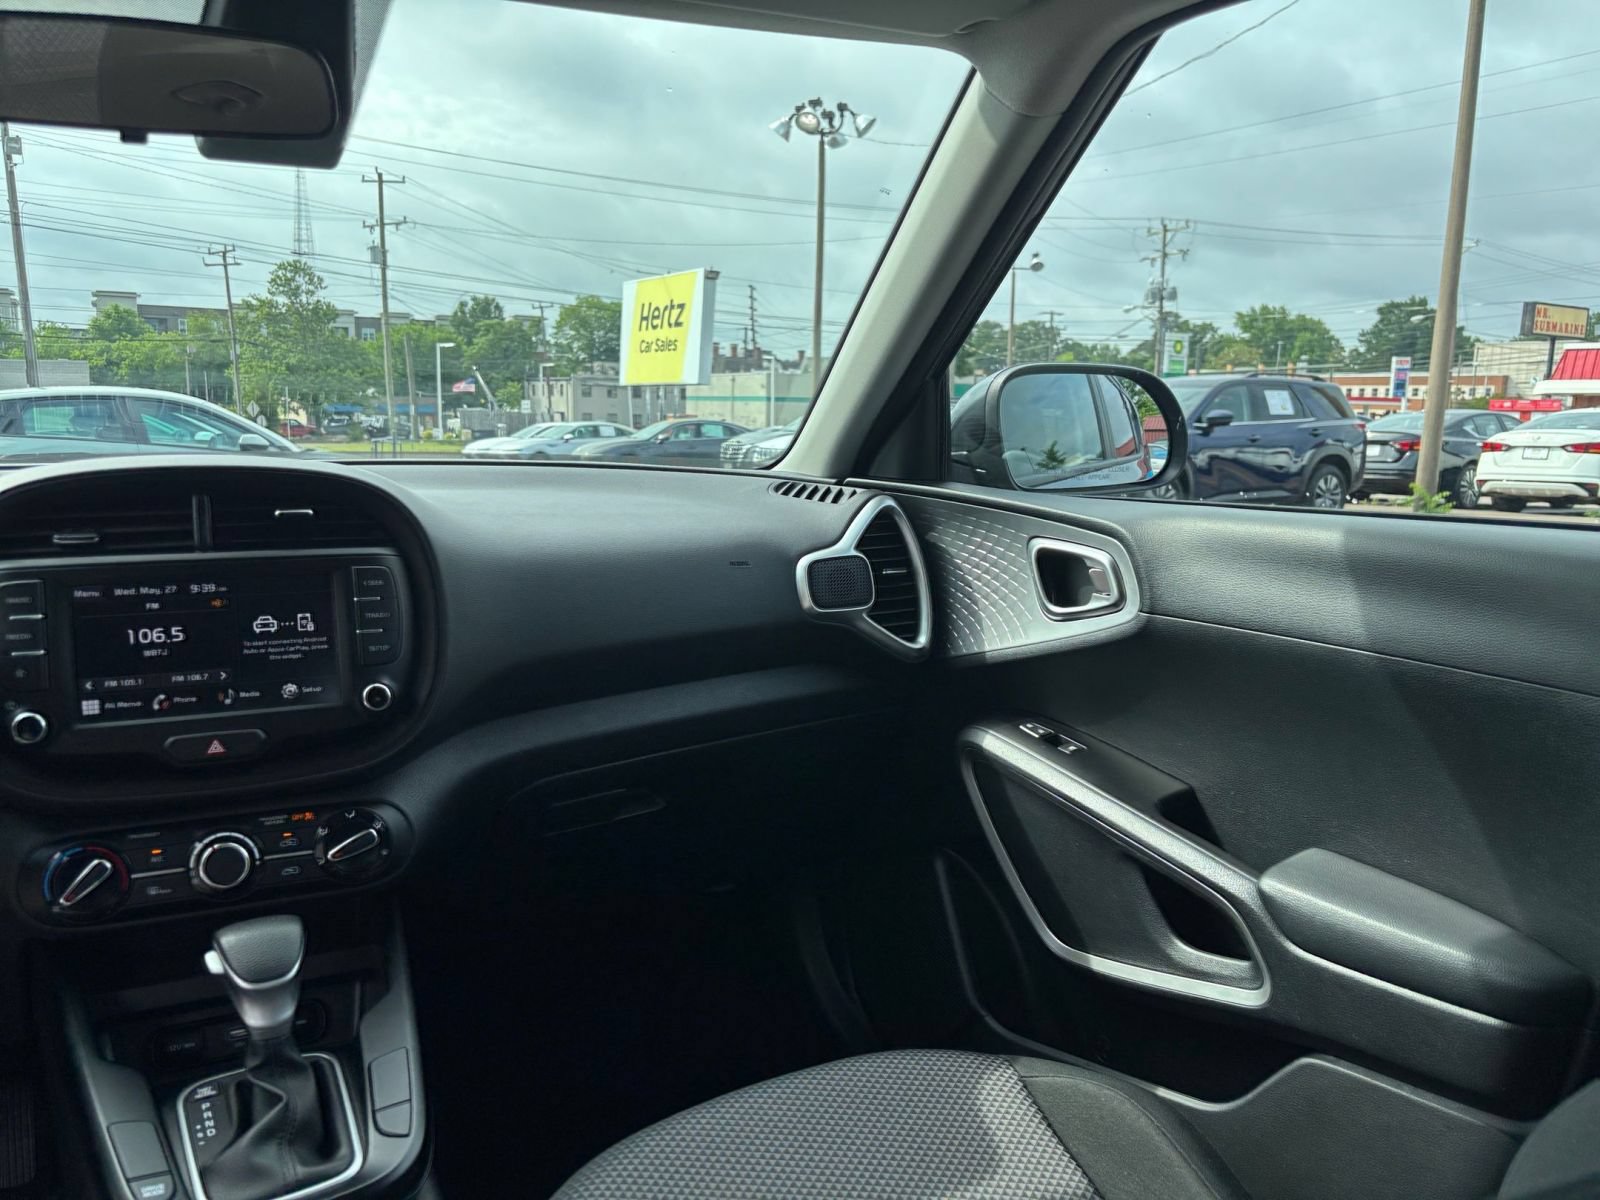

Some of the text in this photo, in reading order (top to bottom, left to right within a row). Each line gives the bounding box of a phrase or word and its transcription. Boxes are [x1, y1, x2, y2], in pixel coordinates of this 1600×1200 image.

[639, 299, 686, 332] Hertz
[1534, 319, 1585, 335] SUBMARINE
[639, 337, 678, 353] Car Sales
[127, 627, 187, 645] 106.5
[201, 1102, 211, 1111] P
[204, 1119, 215, 1128] N
[206, 1128, 216, 1137] D
